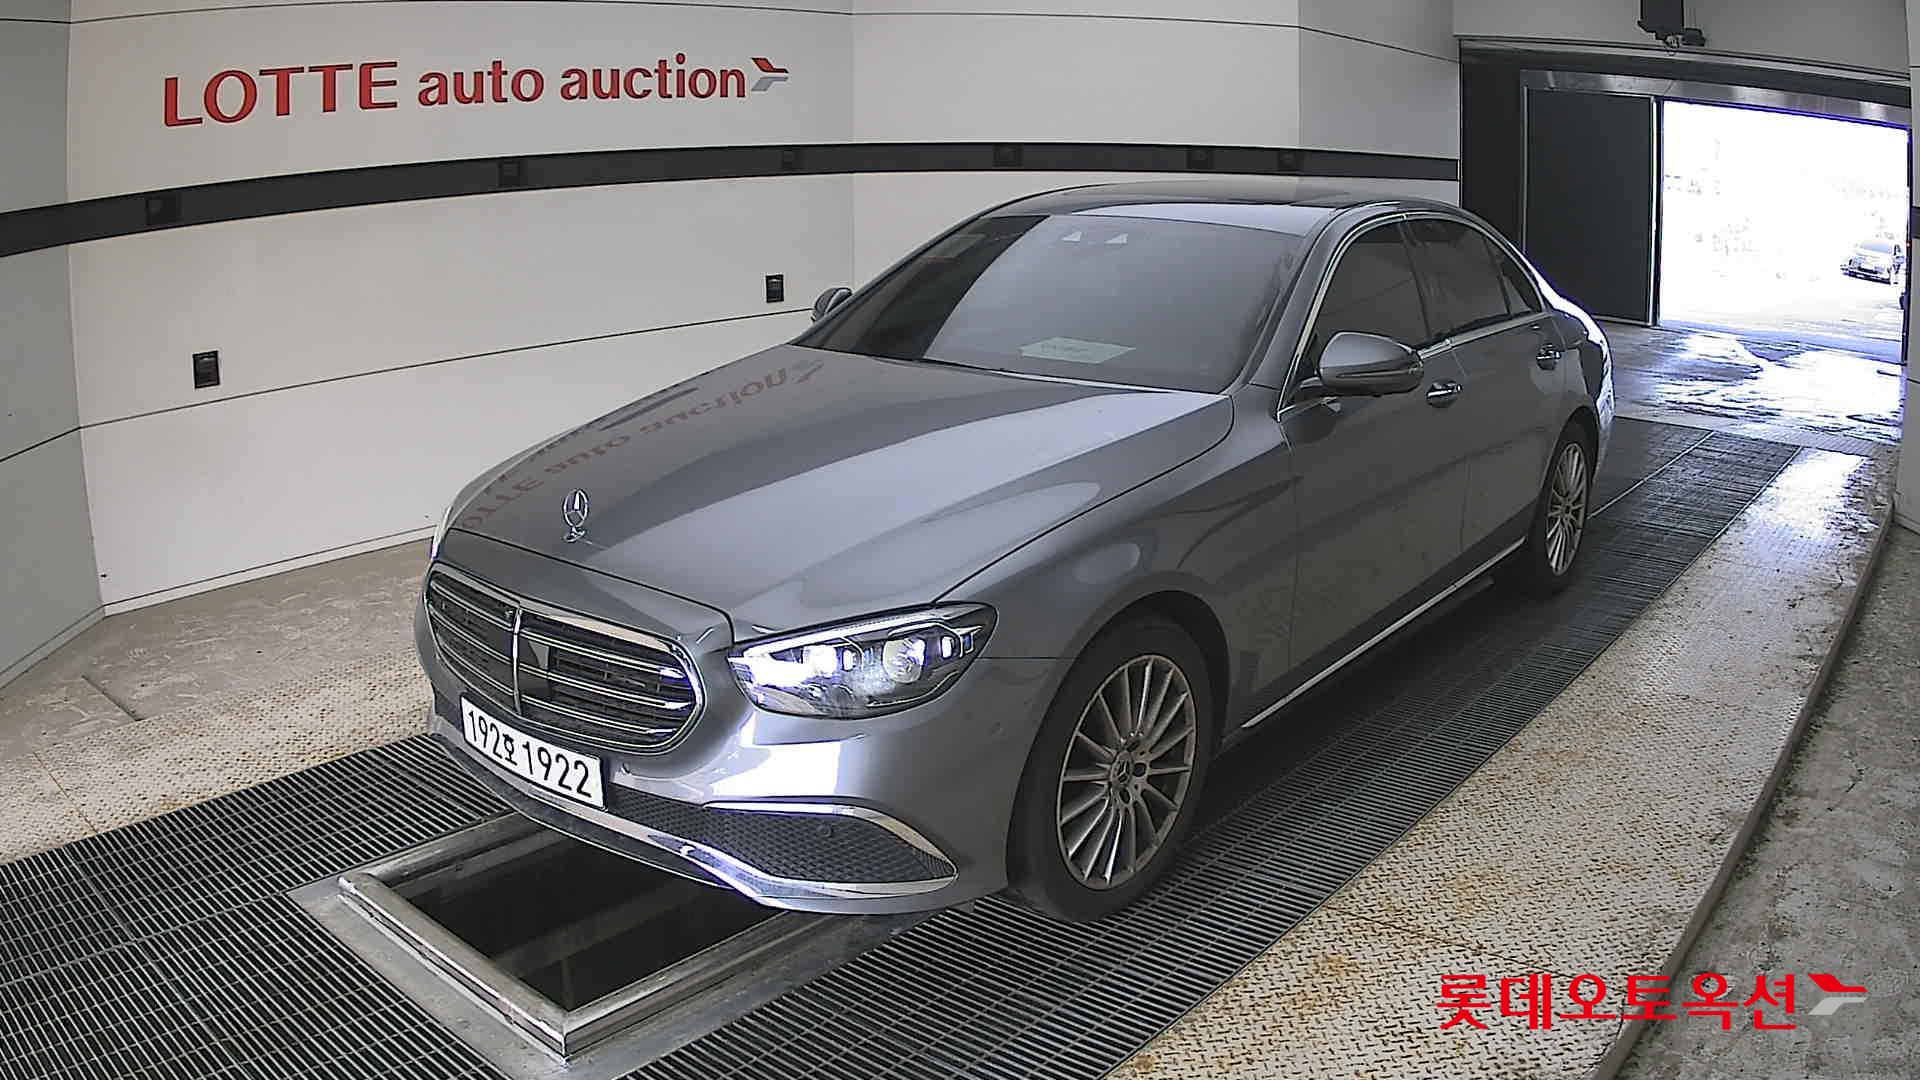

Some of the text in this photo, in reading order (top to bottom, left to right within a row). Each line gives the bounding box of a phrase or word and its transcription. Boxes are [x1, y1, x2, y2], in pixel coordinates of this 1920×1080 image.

[163, 54, 747, 127] LOTTE auto auction
[522, 741, 593, 799] 1922
